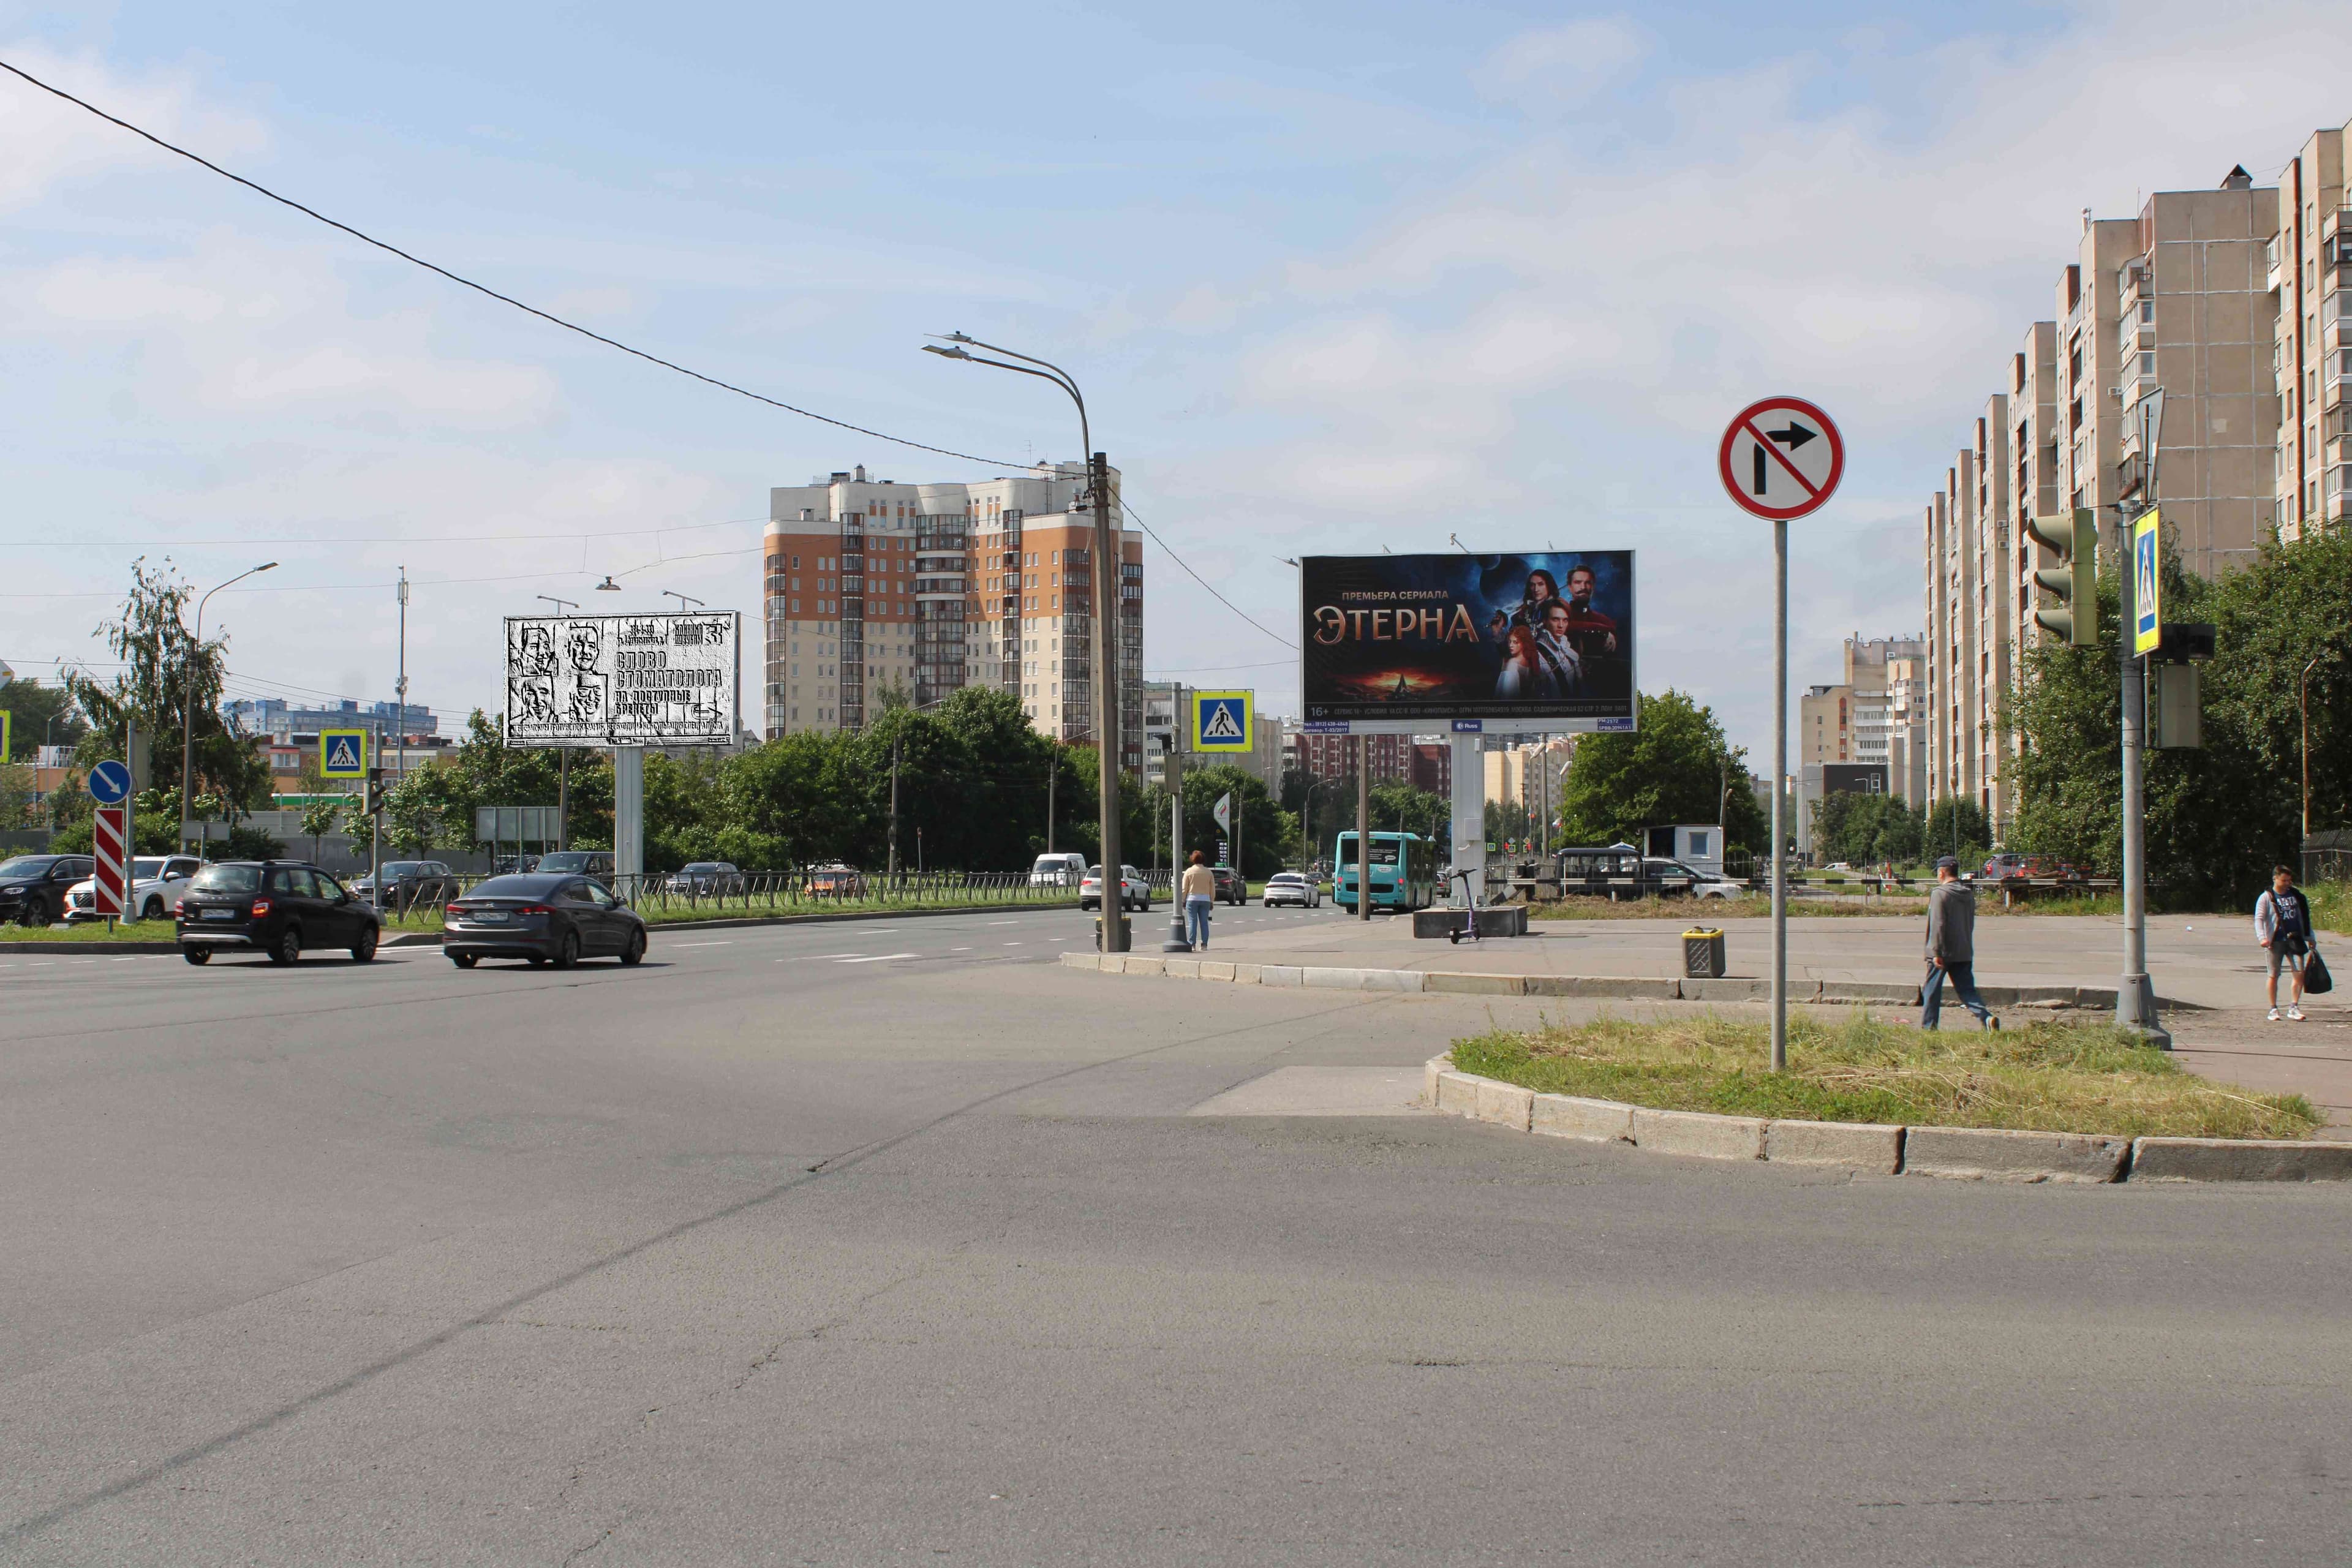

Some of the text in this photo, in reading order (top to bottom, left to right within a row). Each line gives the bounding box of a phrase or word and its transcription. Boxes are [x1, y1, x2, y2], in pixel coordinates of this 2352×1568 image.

[1343, 590, 1449, 600] ПРЕМЬЕРА СЕРИАЛА
[1313, 604, 1480, 644] ЭТЕРНА
[614, 651, 666, 669] СЛОВО
[614, 669, 722, 688] СТОМАТОЛОГА
[614, 690, 690, 703] НА ДОСТУПНЫЕ
[1311, 707, 1329, 716] 16+
